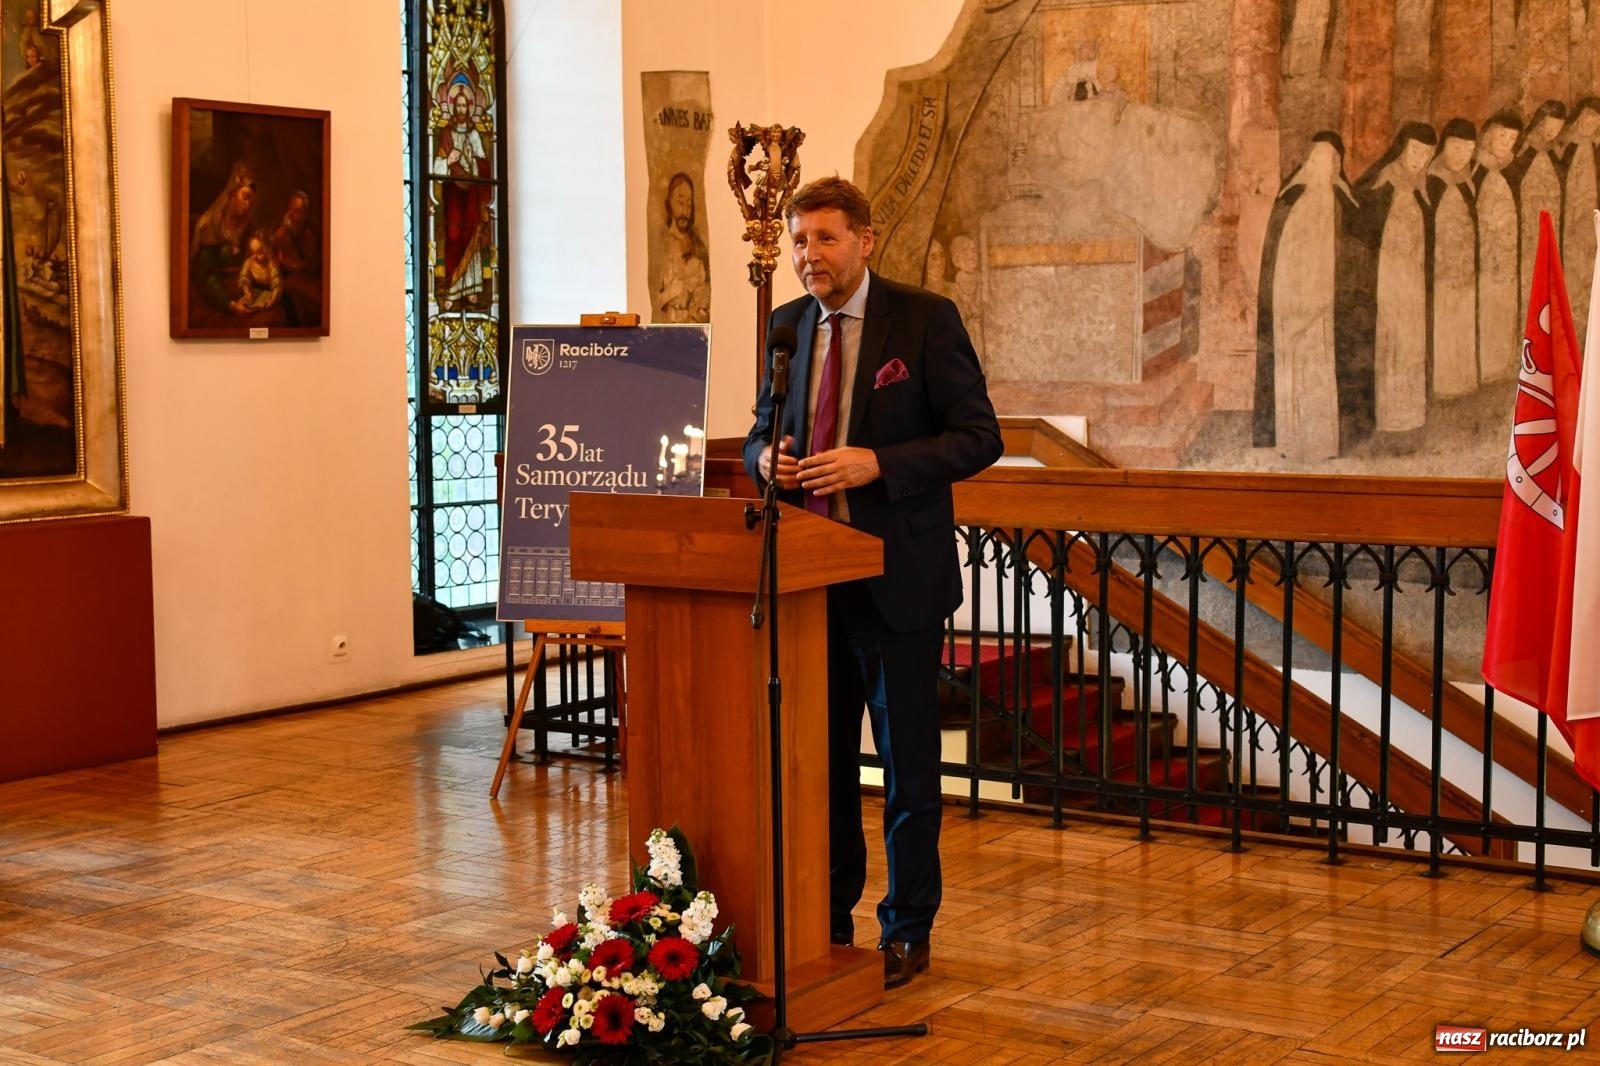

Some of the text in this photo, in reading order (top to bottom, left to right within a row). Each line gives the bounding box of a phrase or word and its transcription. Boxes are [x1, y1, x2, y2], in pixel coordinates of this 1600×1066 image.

[560, 343, 629, 357] Racibórz
[559, 360, 578, 371] 1217
[535, 423, 604, 462] 35 lat
[515, 463, 648, 493] Samorządu
[514, 497, 570, 527] Tery
